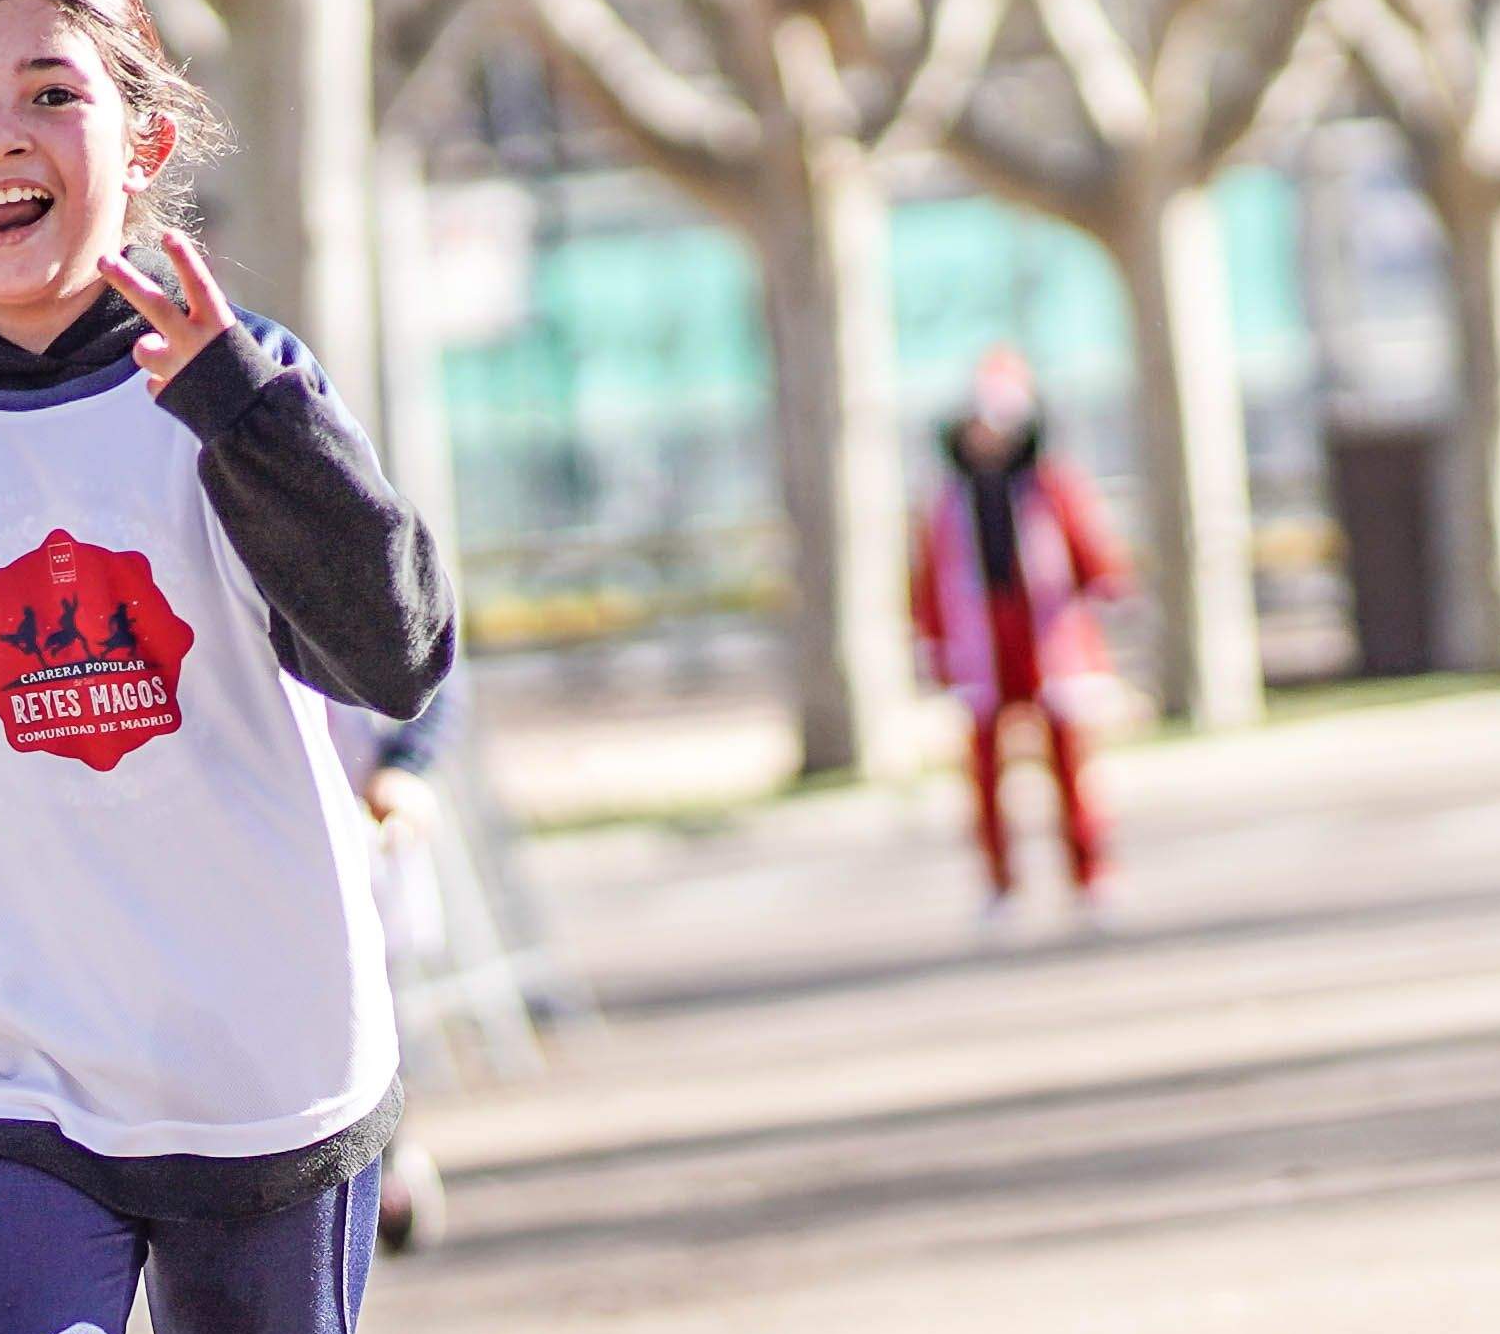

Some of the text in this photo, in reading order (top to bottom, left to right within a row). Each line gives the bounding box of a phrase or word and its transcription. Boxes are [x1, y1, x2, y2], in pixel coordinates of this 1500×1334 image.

[20, 665, 82, 684] CARRERA
[85, 660, 146, 674] POPULAR
[10, 675, 168, 724] REYES MAGOS
[16, 713, 173, 743] COMUNIDAD DE MADRID
